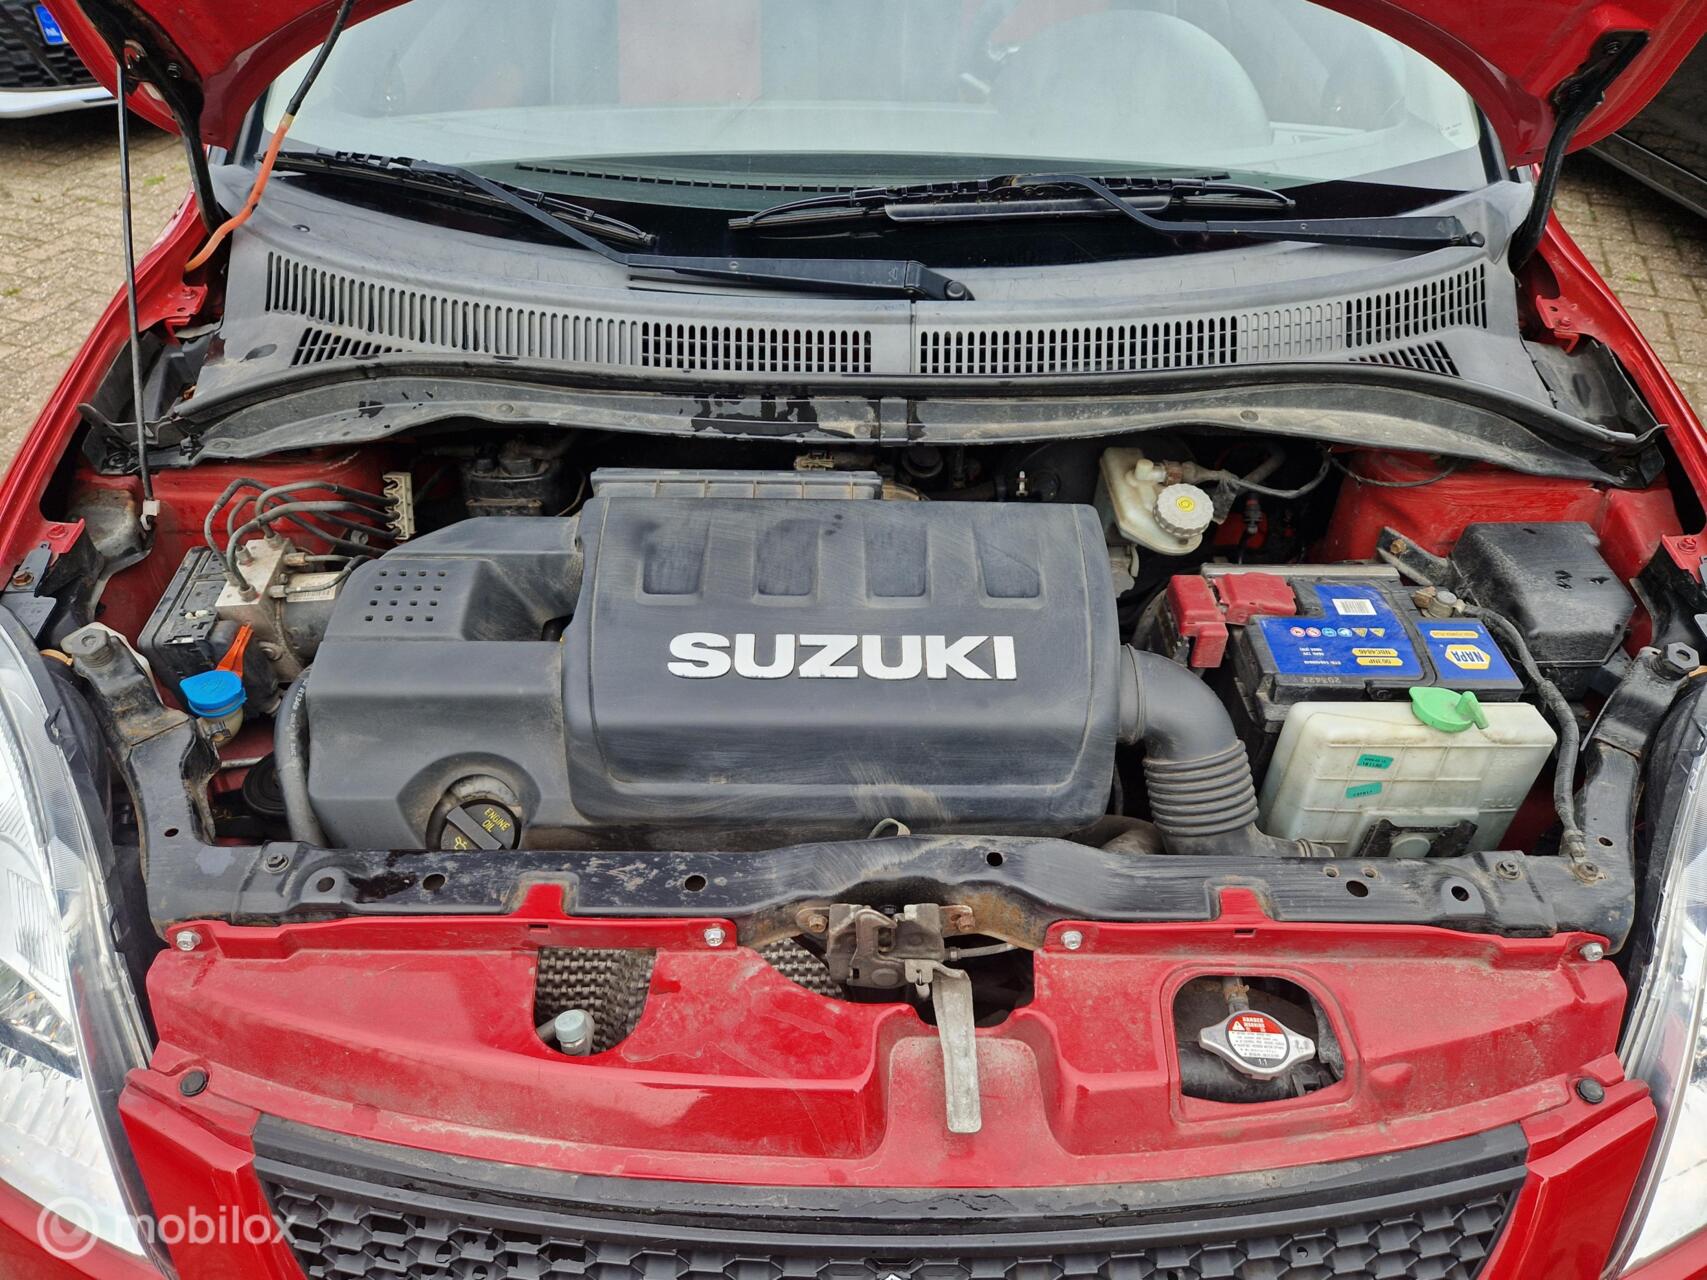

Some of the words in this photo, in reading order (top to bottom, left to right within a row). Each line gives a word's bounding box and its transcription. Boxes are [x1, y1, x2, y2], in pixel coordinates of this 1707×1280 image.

[667, 632, 1017, 680] SUZUKI
[1450, 650, 1484, 662] NAPA
[482, 819, 495, 833] OIL
[484, 807, 511, 831] ENGINE
